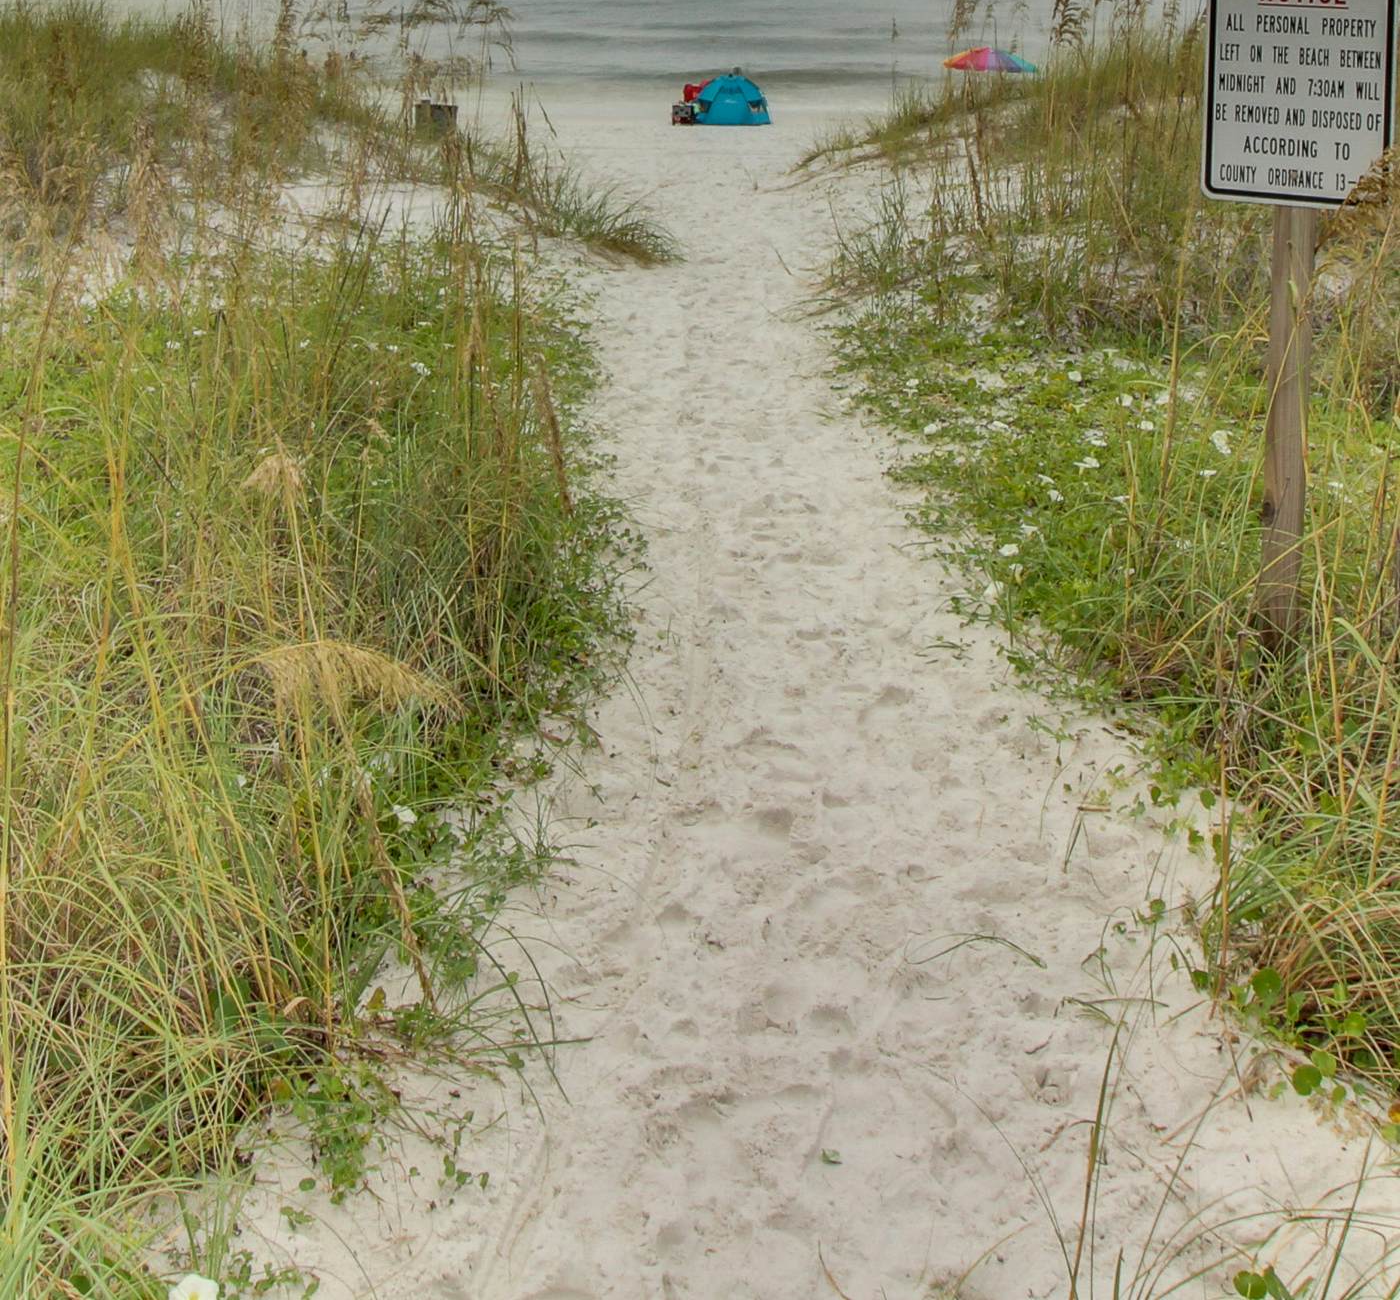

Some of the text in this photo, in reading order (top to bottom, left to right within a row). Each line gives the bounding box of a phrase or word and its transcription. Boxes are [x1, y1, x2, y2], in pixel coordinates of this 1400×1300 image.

[1226, 14, 1376, 37] ALL PERSONAL PROPERTY
[1220, 44, 1381, 68] LEFT ON THE BEACH BETWEEN
[1219, 74, 1380, 101] MIDNIGHT AND 7:30AM WILL
[1216, 103, 1382, 131] BE REMOVED AND DISPOSED OF
[1244, 136, 1350, 160] ACCORDING TO
[1220, 164, 1256, 183] COUNTY
